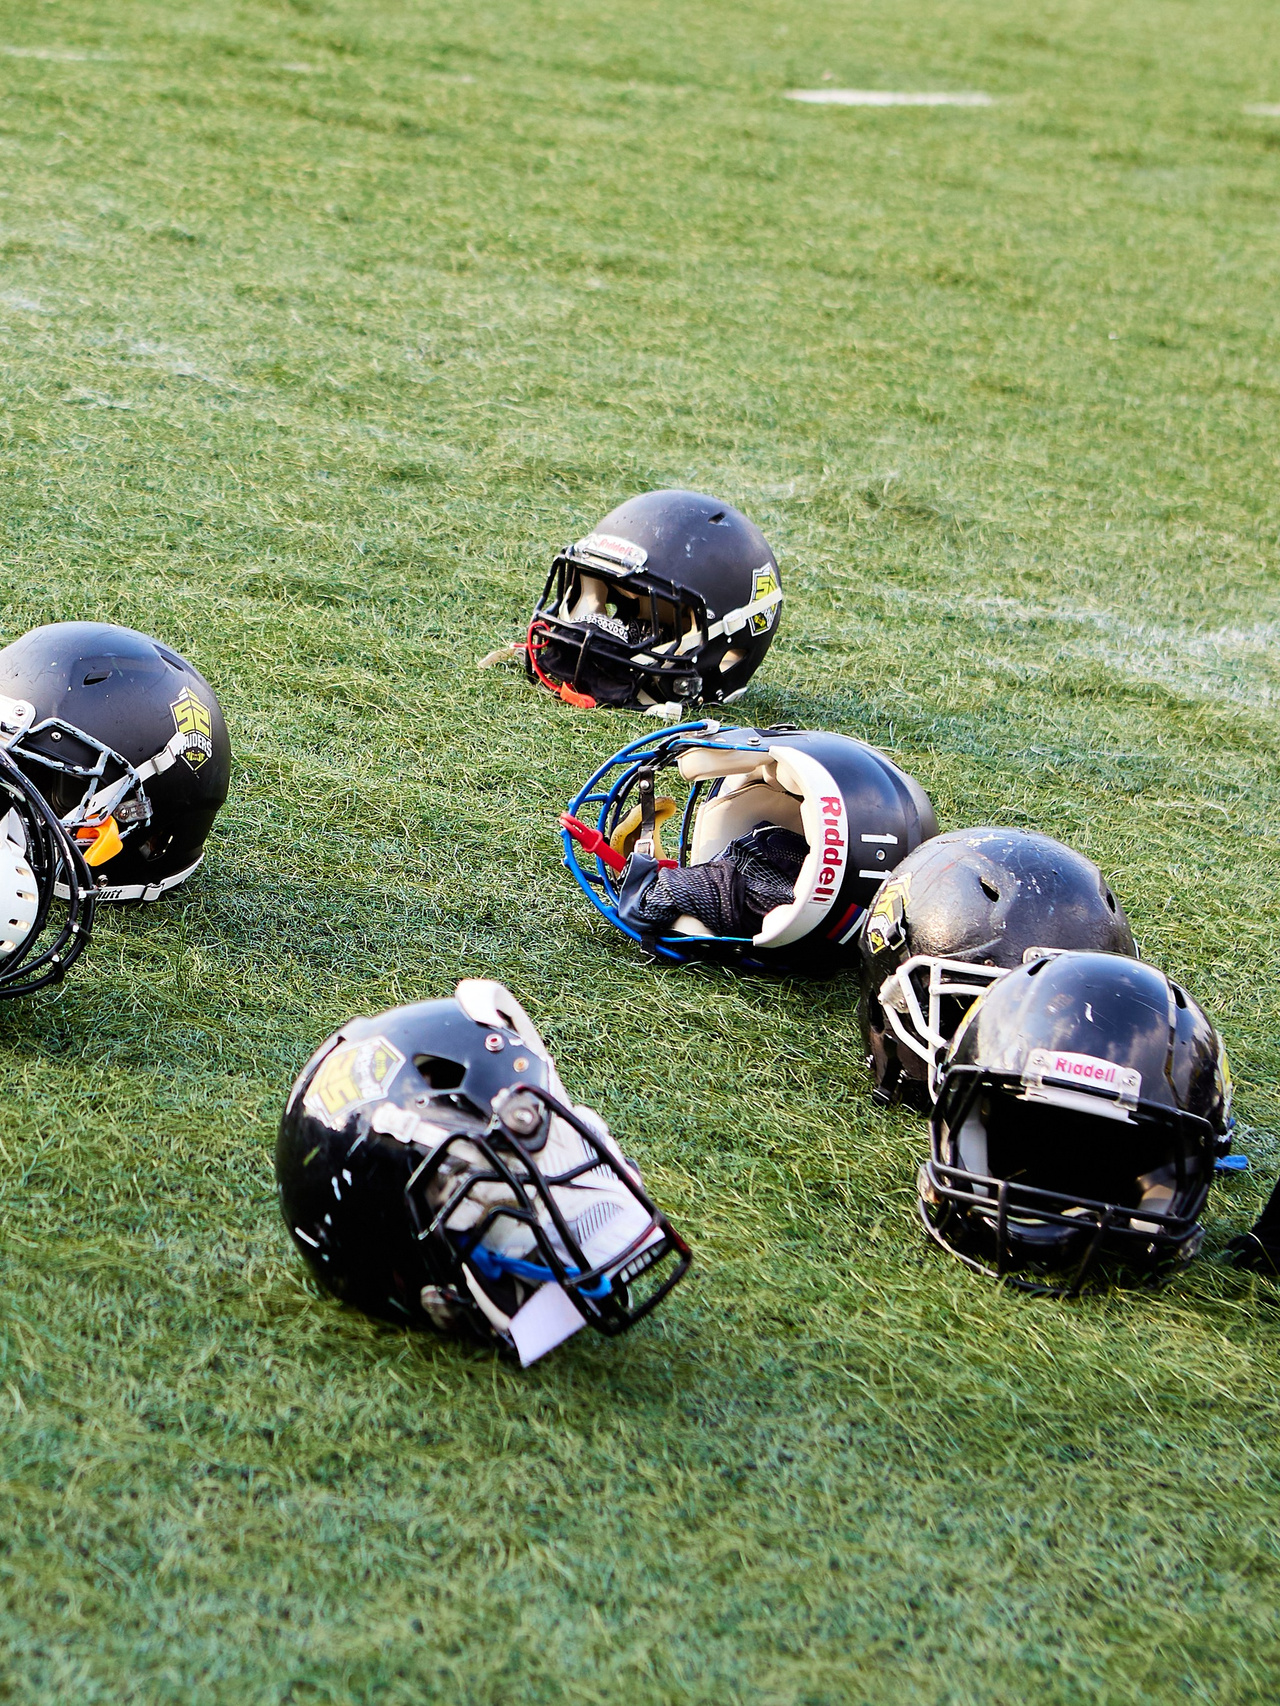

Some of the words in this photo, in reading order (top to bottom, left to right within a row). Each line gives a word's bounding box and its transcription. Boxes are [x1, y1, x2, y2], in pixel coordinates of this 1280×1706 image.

[173, 699, 211, 739] 52
[812, 796, 845, 903] Riddell
[1055, 1057, 1117, 1082] Riddell
